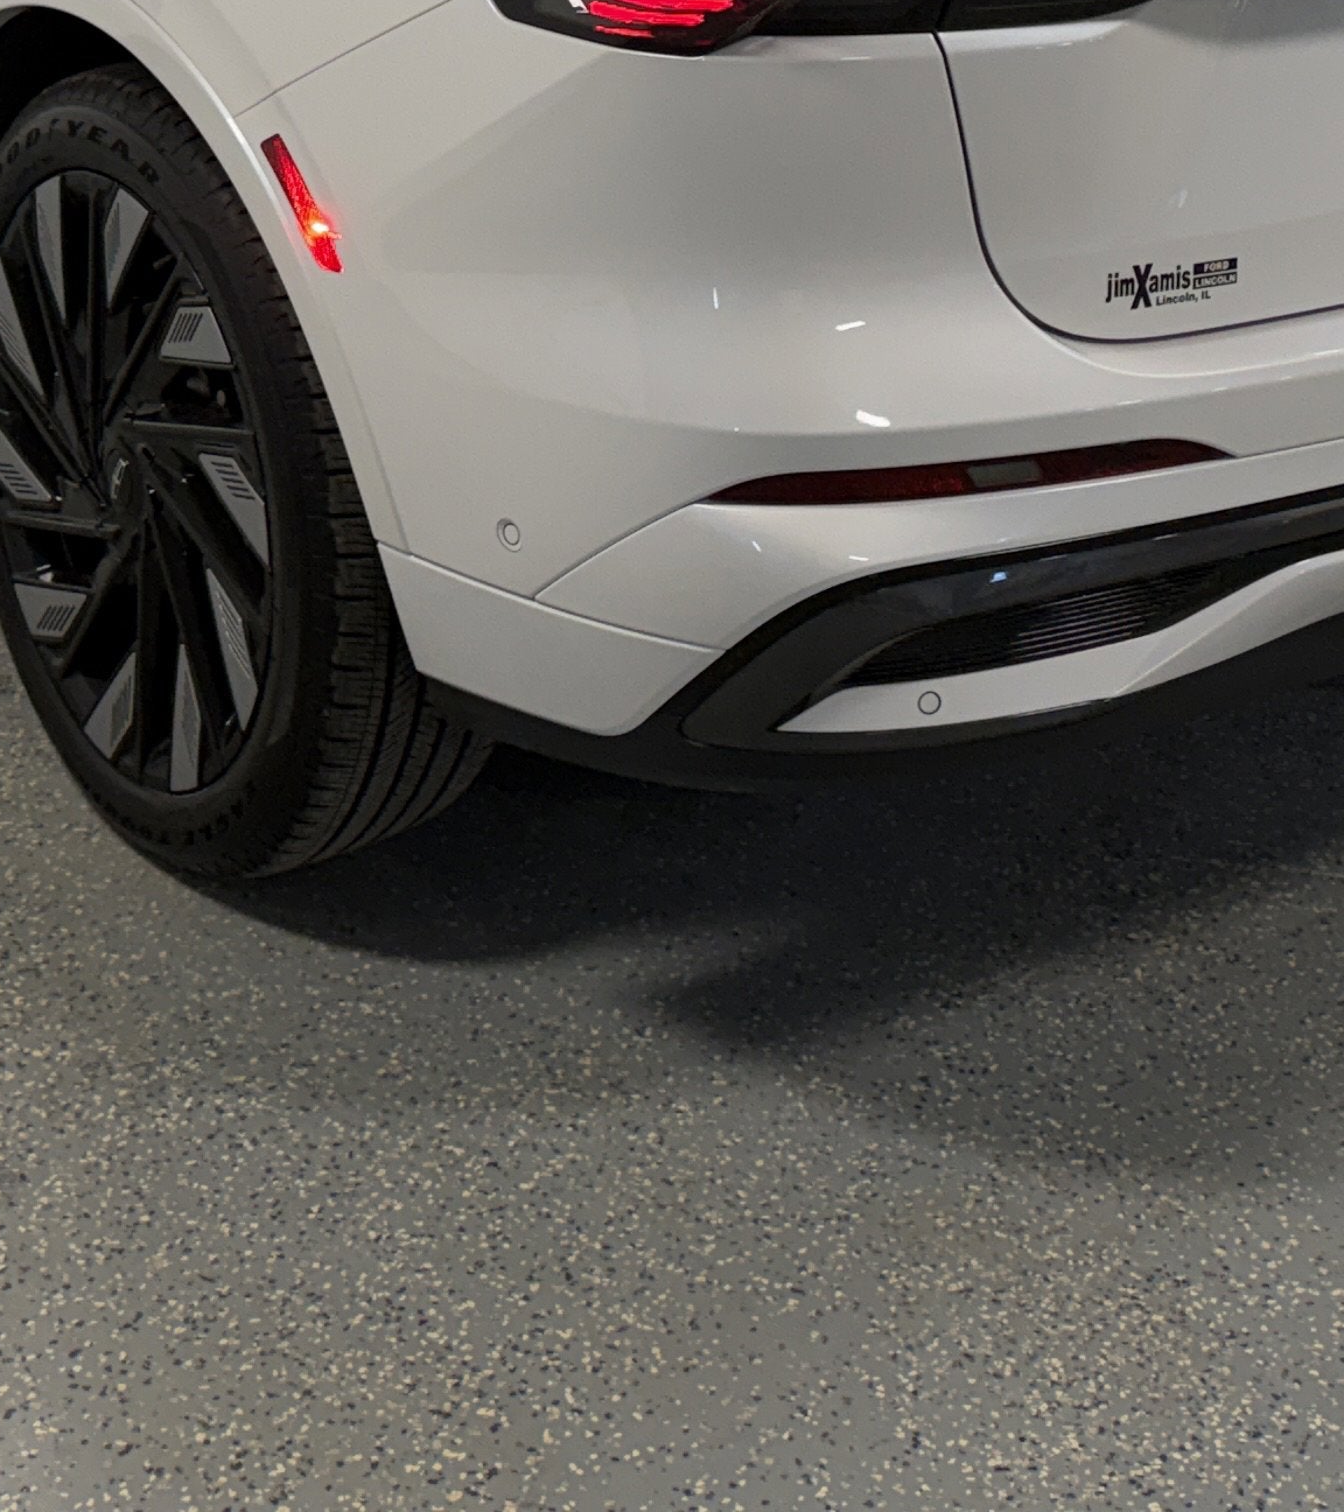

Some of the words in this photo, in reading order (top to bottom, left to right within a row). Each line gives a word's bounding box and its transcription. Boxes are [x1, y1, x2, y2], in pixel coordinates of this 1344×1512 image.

[1203, 260, 1230, 273] FORD
[1105, 263, 1191, 310] jimXamis
[1195, 274, 1237, 288] LINCOLN
[1156, 292, 1198, 306] Lincoln,
[1201, 290, 1211, 300] IL
